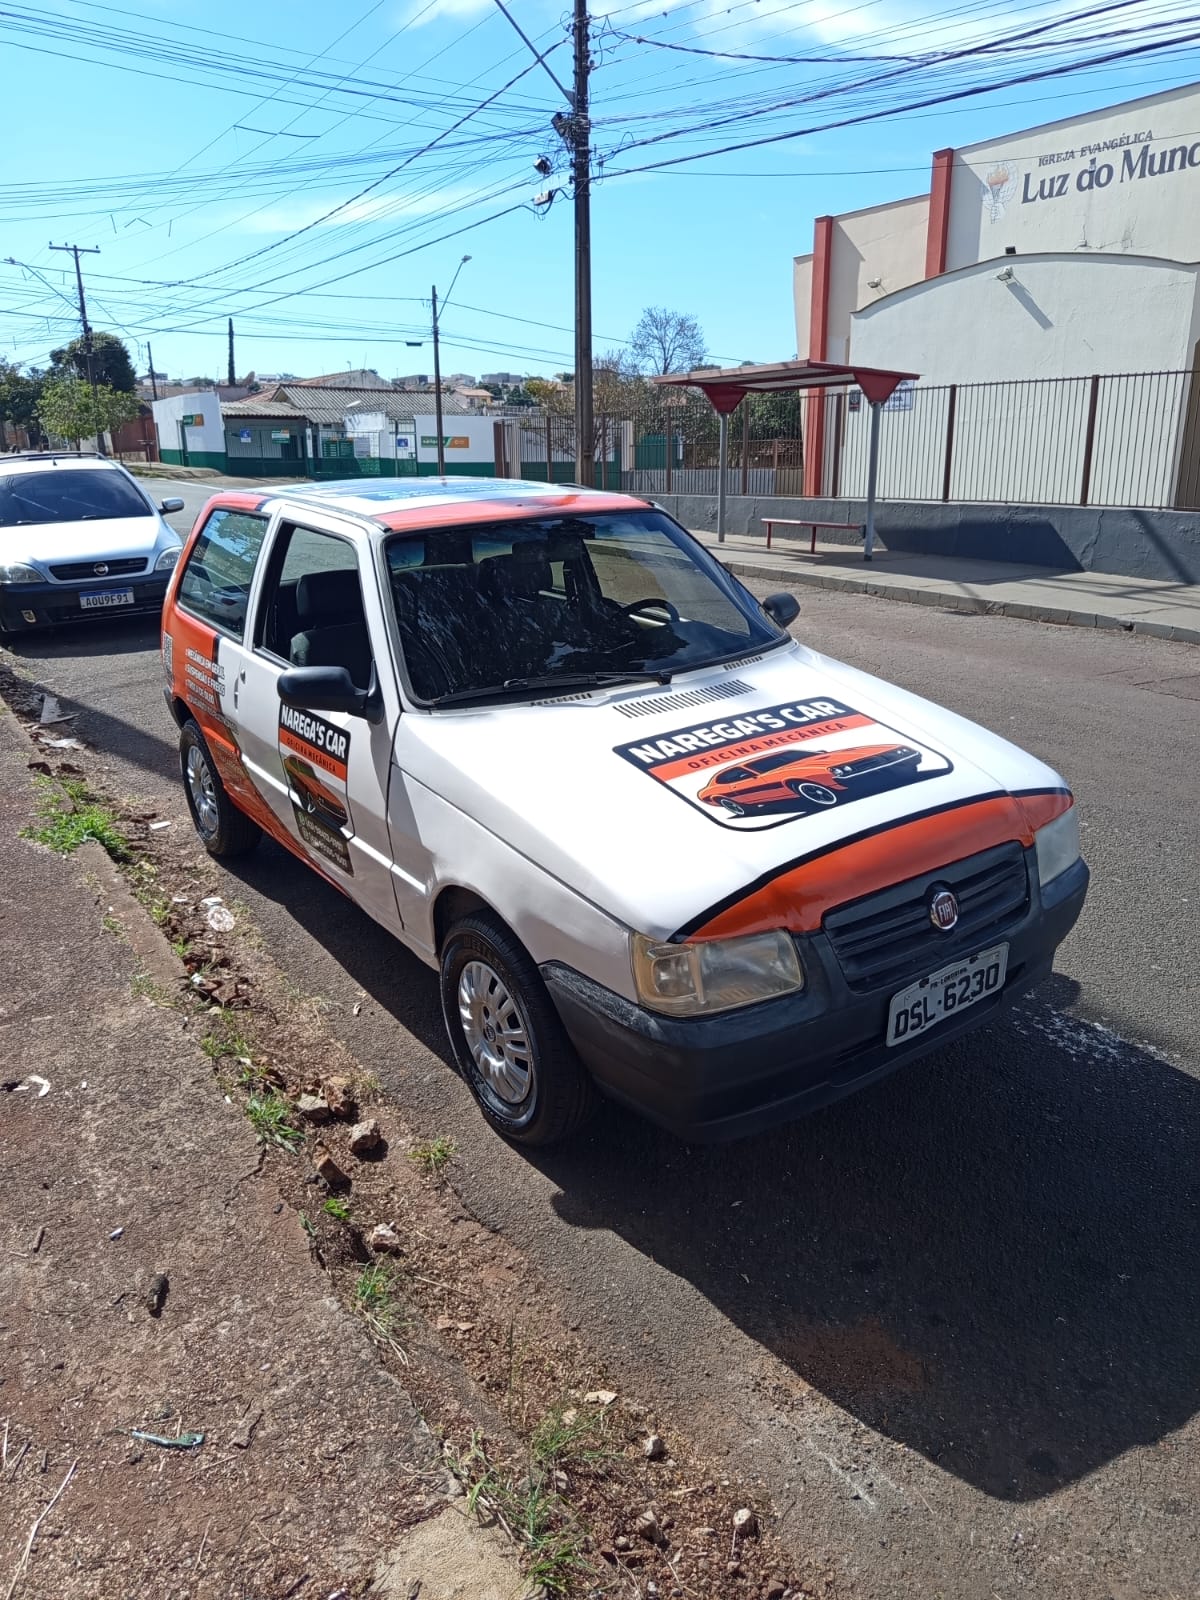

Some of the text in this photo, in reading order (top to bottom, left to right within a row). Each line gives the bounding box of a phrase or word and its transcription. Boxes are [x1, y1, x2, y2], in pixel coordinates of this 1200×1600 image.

[1038, 129, 1154, 168] IGREJA EVANGÉLICA
[1021, 172, 1070, 204] Luz
[1076, 157, 1114, 192] do
[281, 704, 326, 746] NAREGA'S
[325, 728, 347, 758] CAR
[627, 700, 847, 764] NAREGA'S CAR
[687, 721, 848, 769] OFICINA MECÂNICA
[938, 900, 953, 922] FIAT
